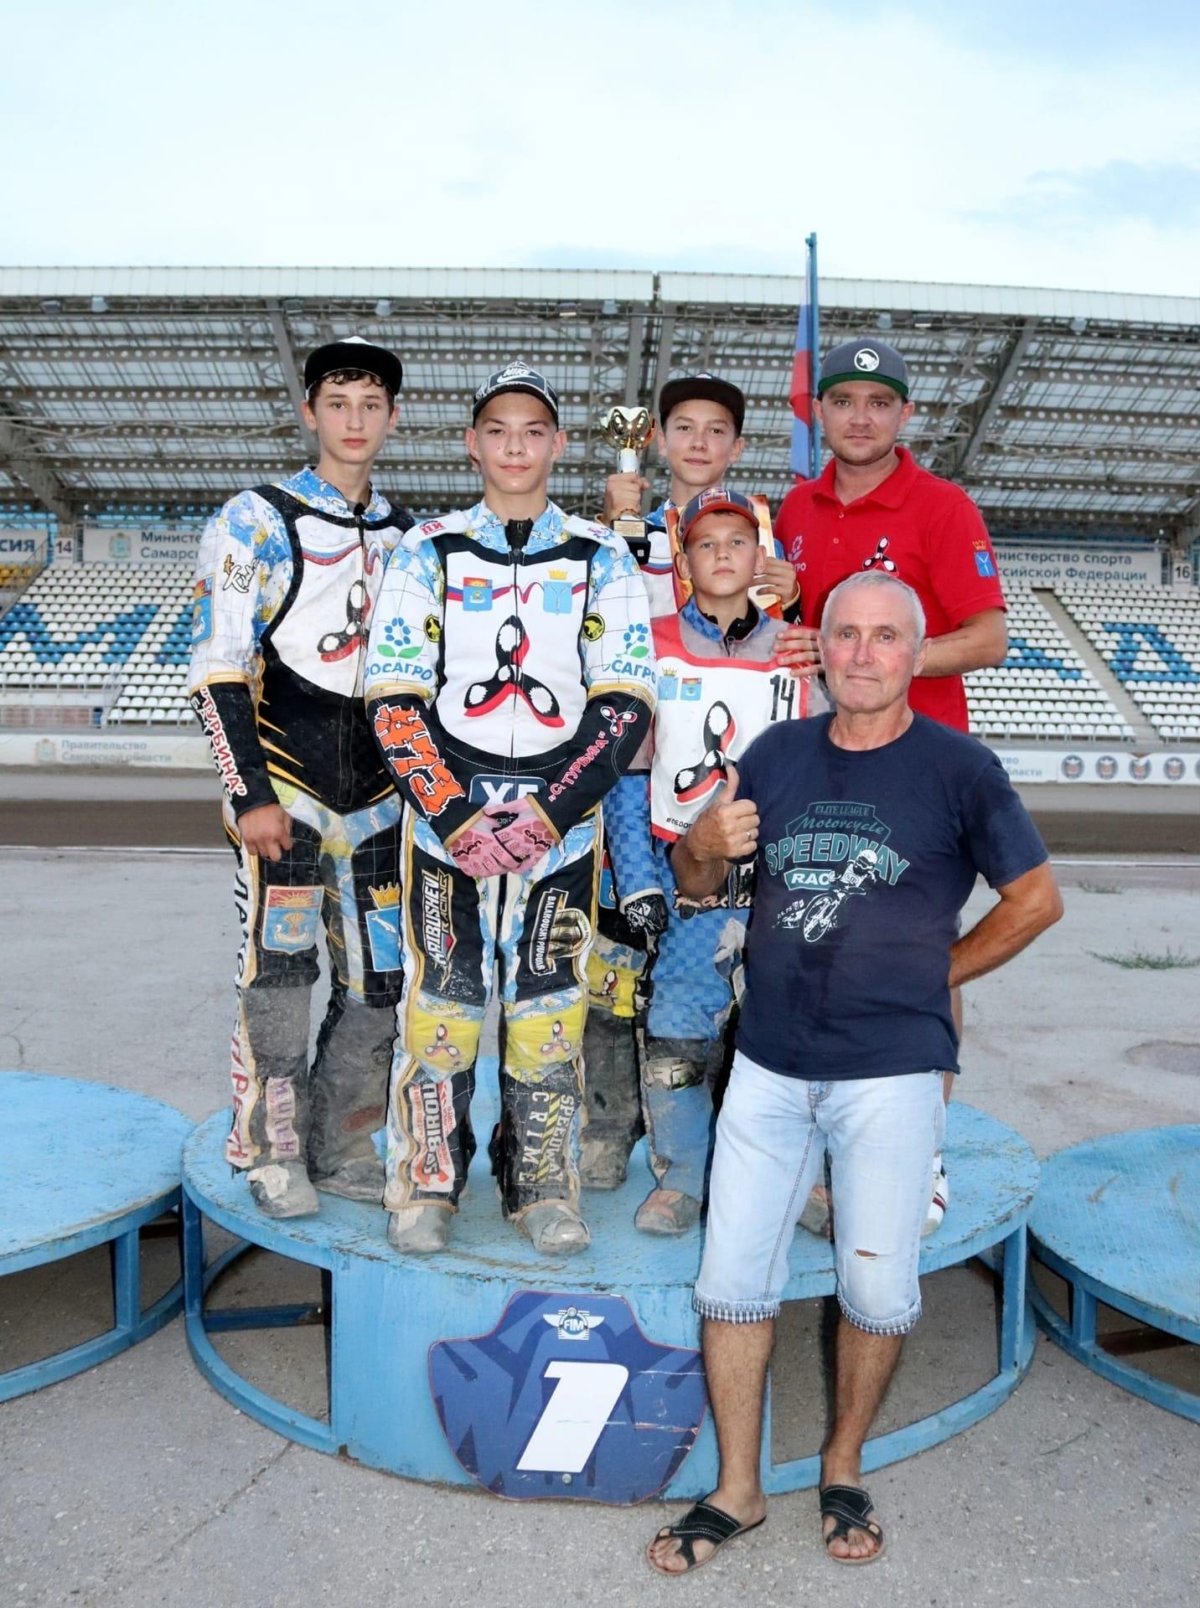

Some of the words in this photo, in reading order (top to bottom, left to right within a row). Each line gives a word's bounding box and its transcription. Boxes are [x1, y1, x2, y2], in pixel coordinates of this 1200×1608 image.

[56, 541, 73, 554] 14
[1084, 554, 1132, 567] спорта
[998, 566, 1061, 579] сийской
[1065, 566, 1148, 581] Федерации
[1175, 565, 1191, 579] 16
[770, 674, 796, 721] 14
[815, 804, 838, 816] ELITE
[839, 805, 870, 817] LEAGUE
[793, 816, 886, 836] Motorcycle
[764, 832, 911, 887] SPEEDWAY
[440, 875, 450, 933] RACING
[518, 1091, 550, 1182] CRIME
[548, 1094, 575, 1182] SPEEDWAY
[563, 1318, 585, 1332] FIM
[516, 1360, 629, 1474] 1
